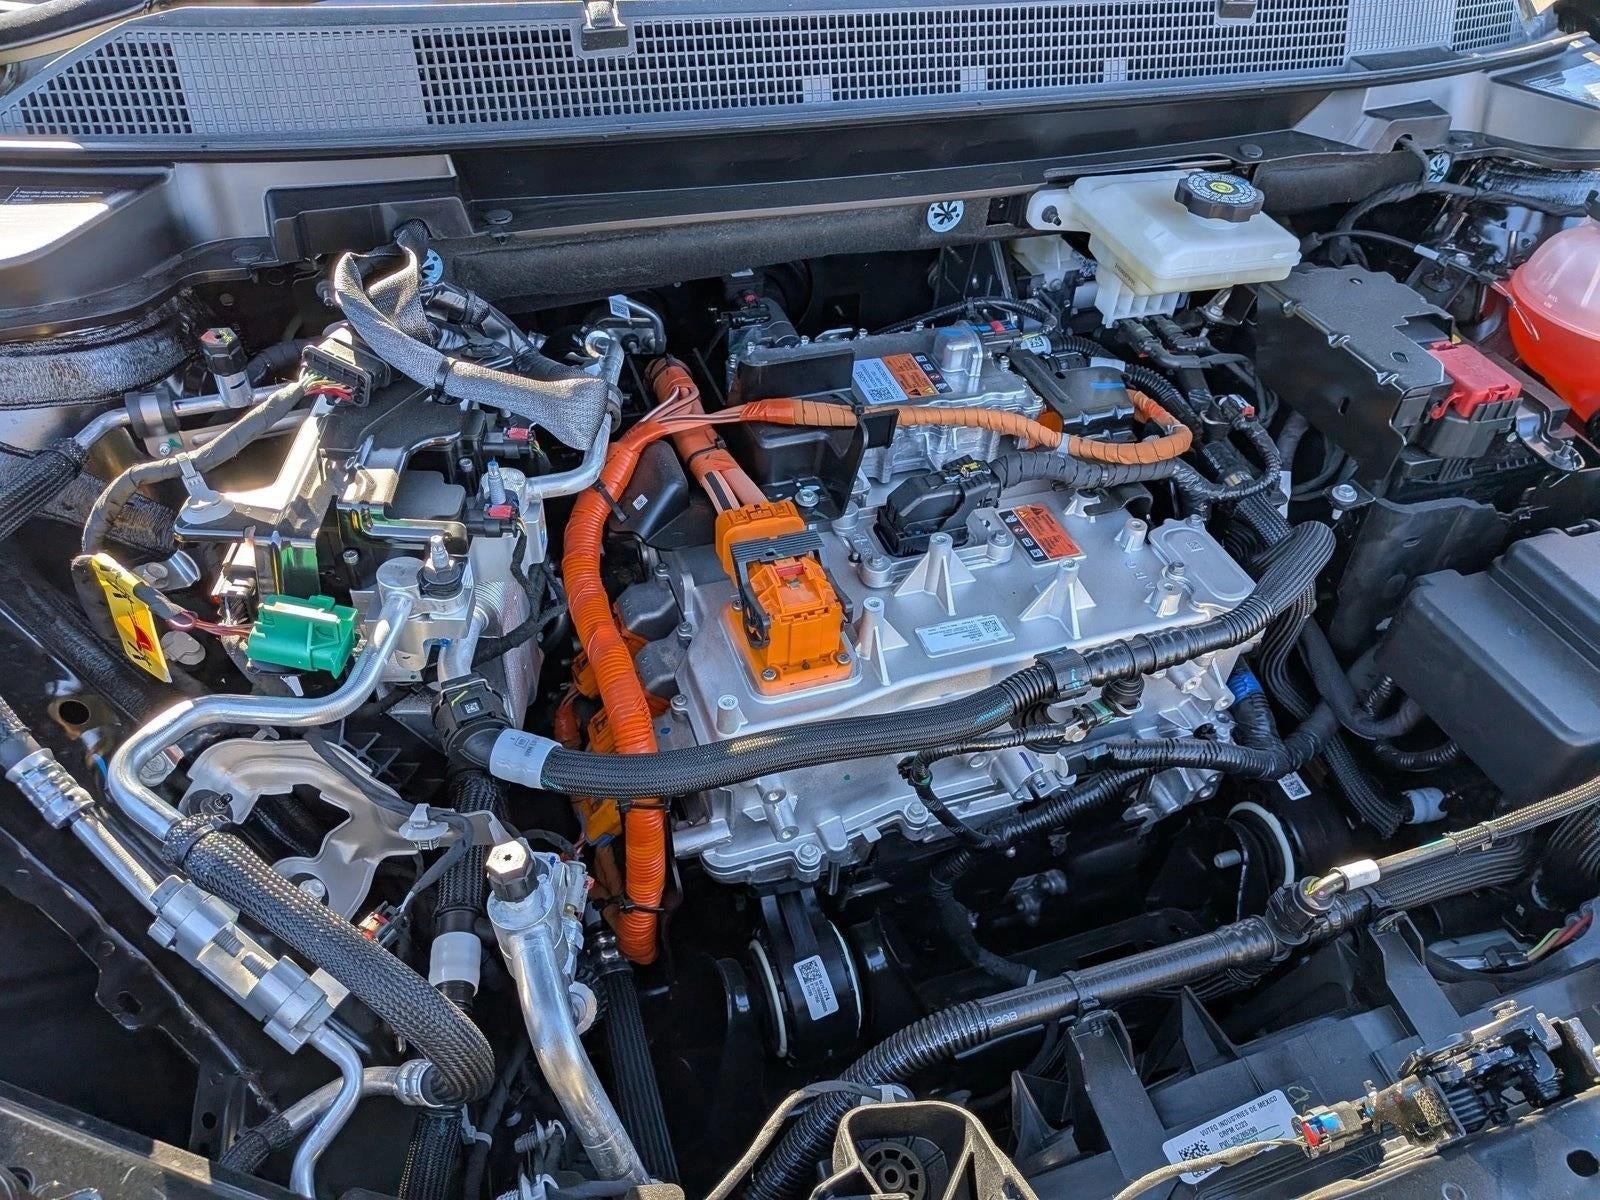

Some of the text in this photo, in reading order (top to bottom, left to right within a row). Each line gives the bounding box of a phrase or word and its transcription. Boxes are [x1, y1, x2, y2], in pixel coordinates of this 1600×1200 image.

[1219, 1110, 1249, 1129] INDUSTRIES
[1250, 1105, 1257, 1114] DE
[1258, 1096, 1278, 1110] MEXICO
